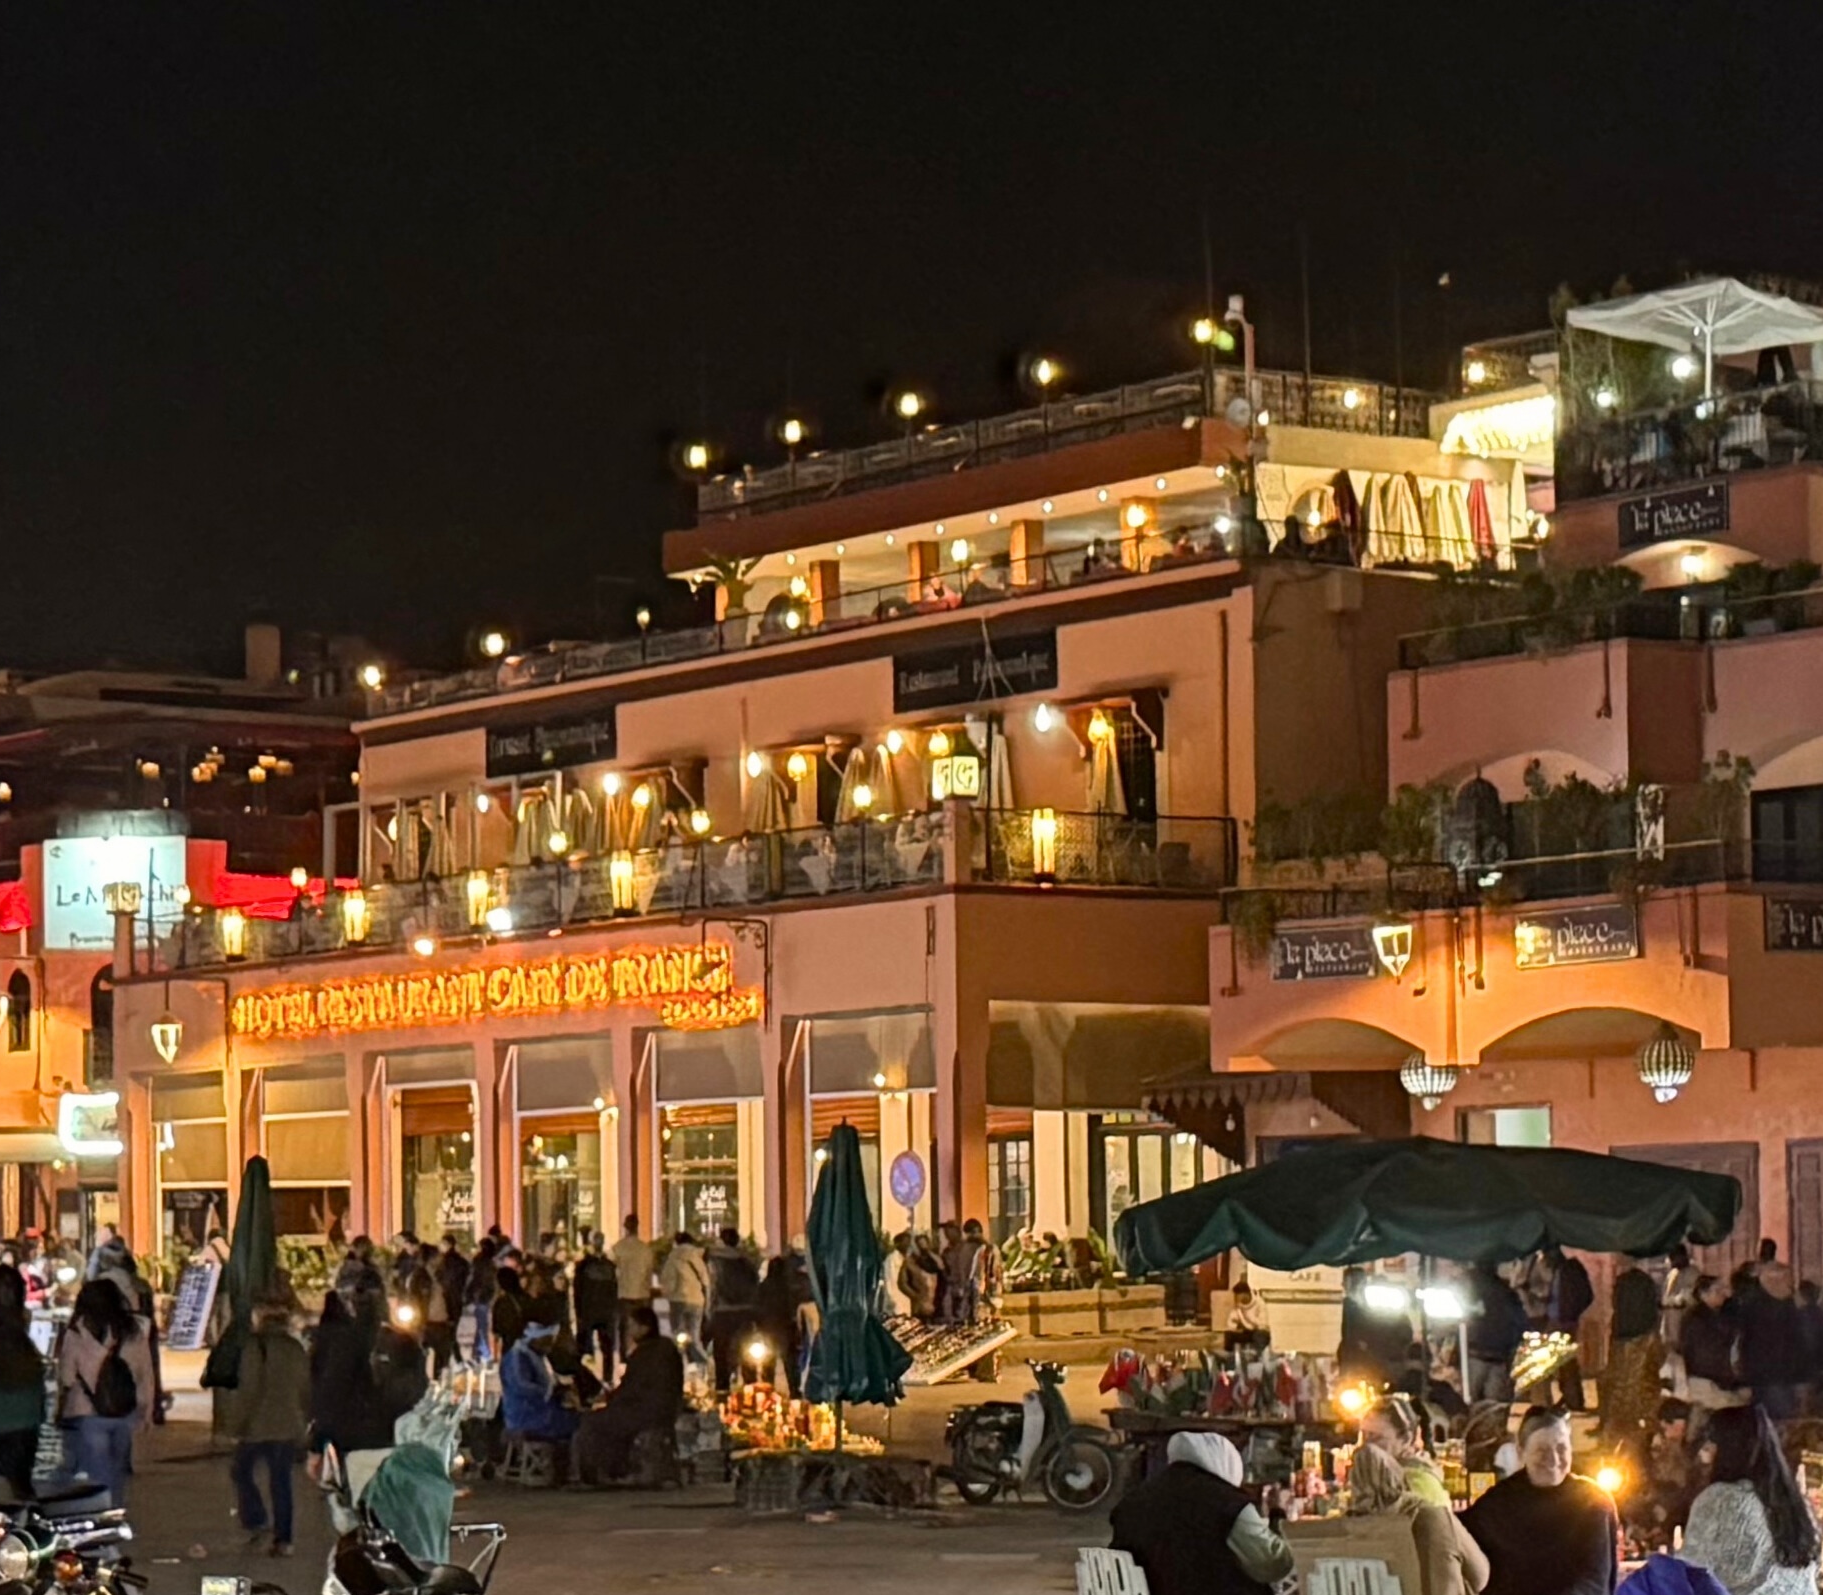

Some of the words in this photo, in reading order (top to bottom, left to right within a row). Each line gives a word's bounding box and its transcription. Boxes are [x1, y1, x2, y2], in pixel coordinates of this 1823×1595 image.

[1304, 935, 1352, 973] place
[1557, 917, 1610, 956] place
[233, 988, 316, 1035] HOTEL
[317, 968, 486, 1026] RESTAURANT
[612, 944, 733, 999] FRANCE
